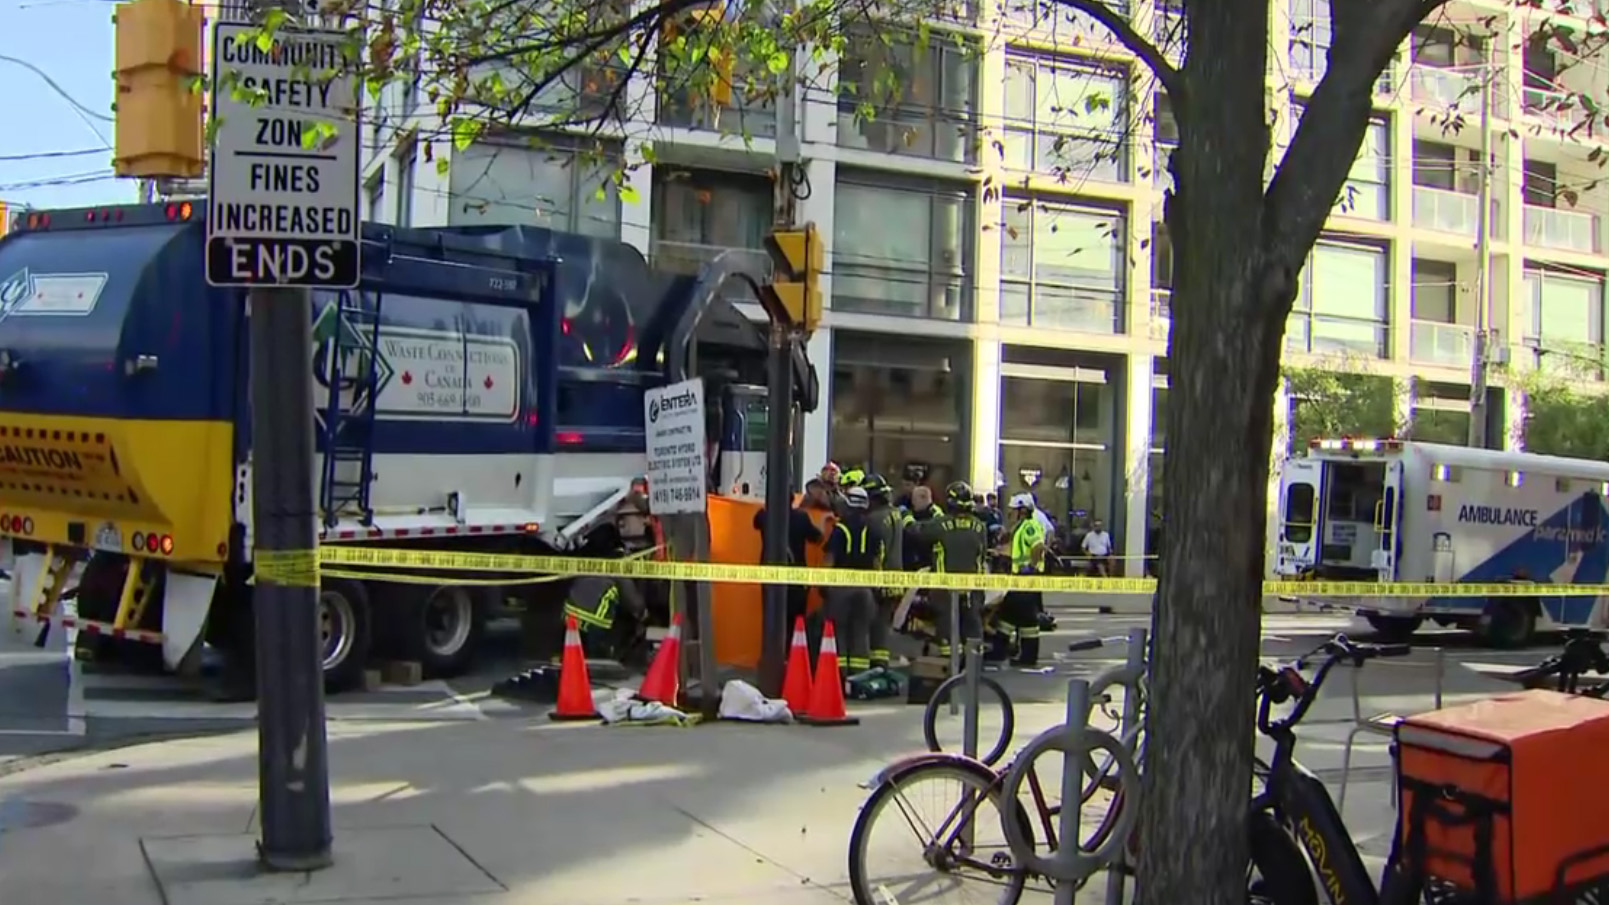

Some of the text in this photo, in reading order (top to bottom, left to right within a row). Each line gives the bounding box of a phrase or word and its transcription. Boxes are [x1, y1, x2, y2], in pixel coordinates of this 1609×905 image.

[256, 118, 303, 146] ZON
[251, 163, 320, 193] FINES
[217, 203, 351, 235] INCREASED
[231, 243, 336, 279] ENDS
[427, 343, 508, 366] CONNCTIONS
[661, 388, 698, 411] ENTERA
[1457, 504, 1539, 527] AMBULANCE
